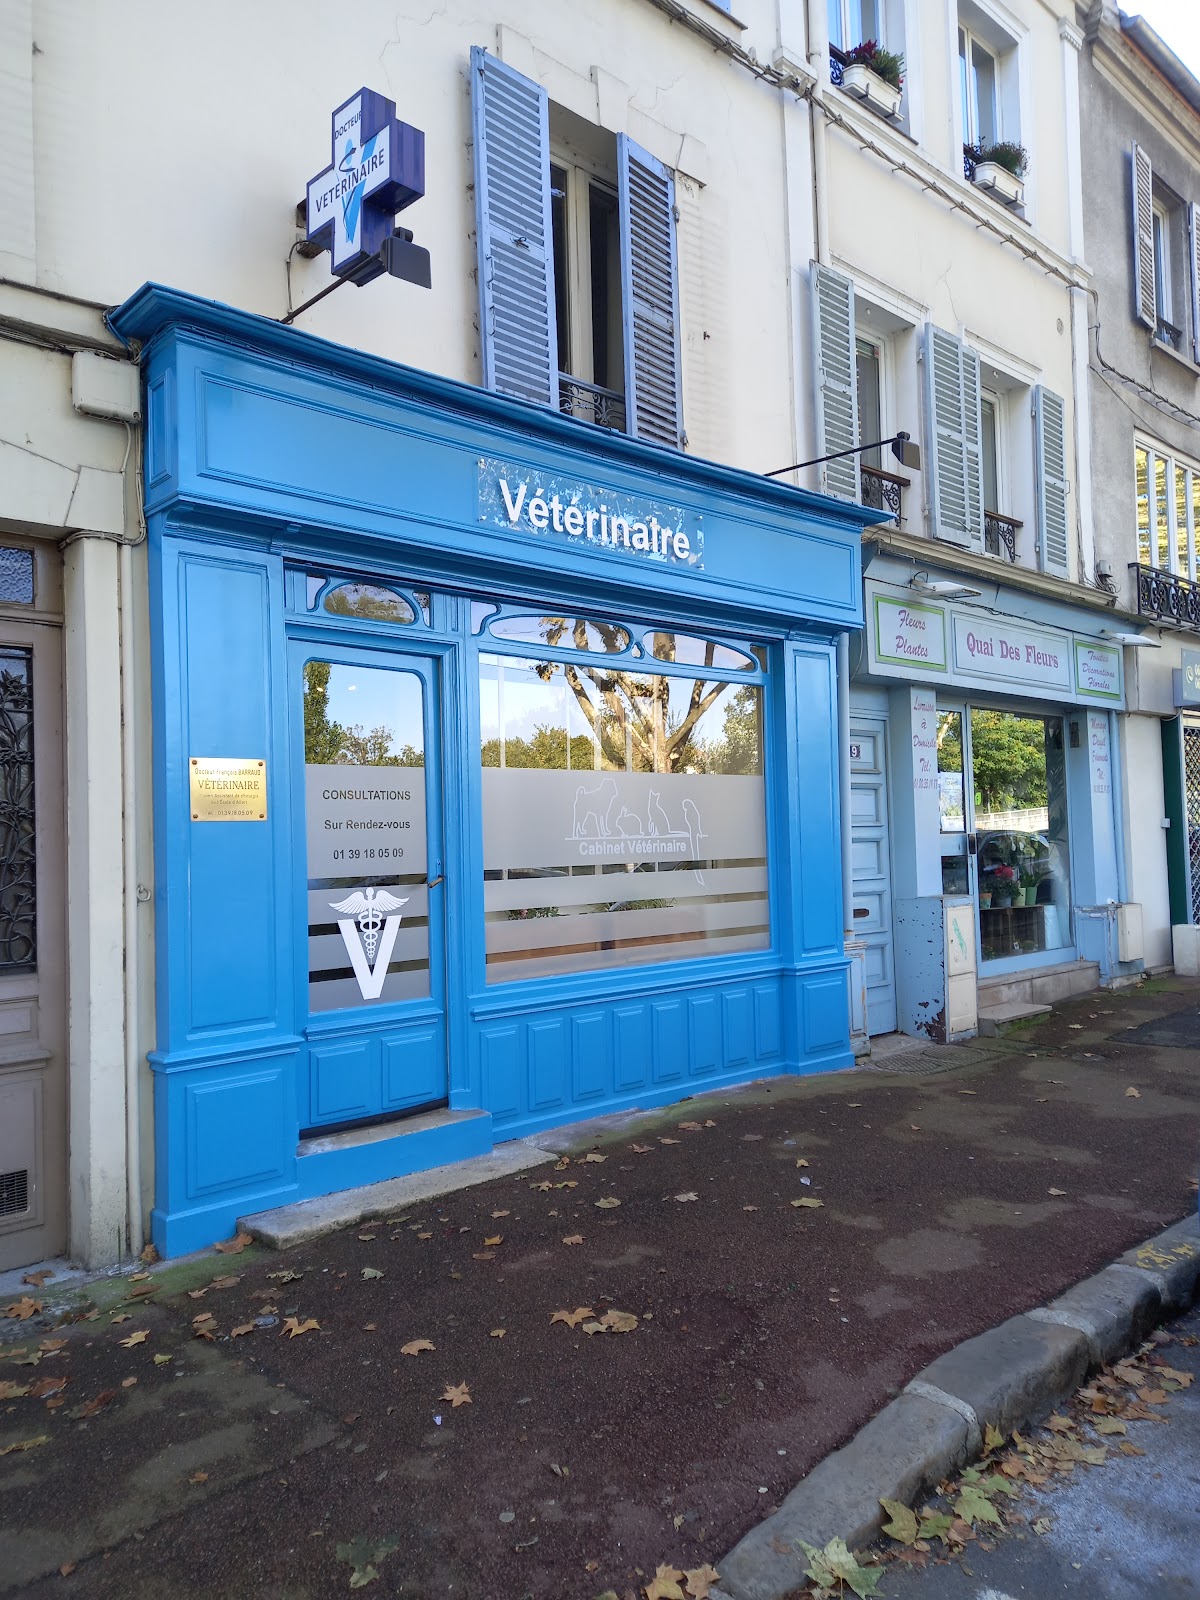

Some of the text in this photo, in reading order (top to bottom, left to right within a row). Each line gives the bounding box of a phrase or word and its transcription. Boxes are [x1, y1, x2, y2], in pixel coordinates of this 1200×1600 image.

[334, 110, 362, 140] DOCTEUR
[315, 148, 385, 212] VETERINAIRE
[499, 478, 690, 559] Vétérinaire
[898, 609, 926, 630] Fleurs
[895, 634, 928, 657] Plantes
[966, 632, 1059, 668] Quai Des Fleurs
[1088, 650, 1109, 662] Toutes
[1088, 677, 1110, 689] Florales
[198, 778, 260, 790] VÉTÉRINAIRE
[322, 789, 411, 801] CONSULTATIONS
[324, 819, 411, 830] Sur Rendez-vous
[333, 847, 404, 860] 01 39 18 05 09
[578, 839, 687, 855] Cabinet Vétérinaire
